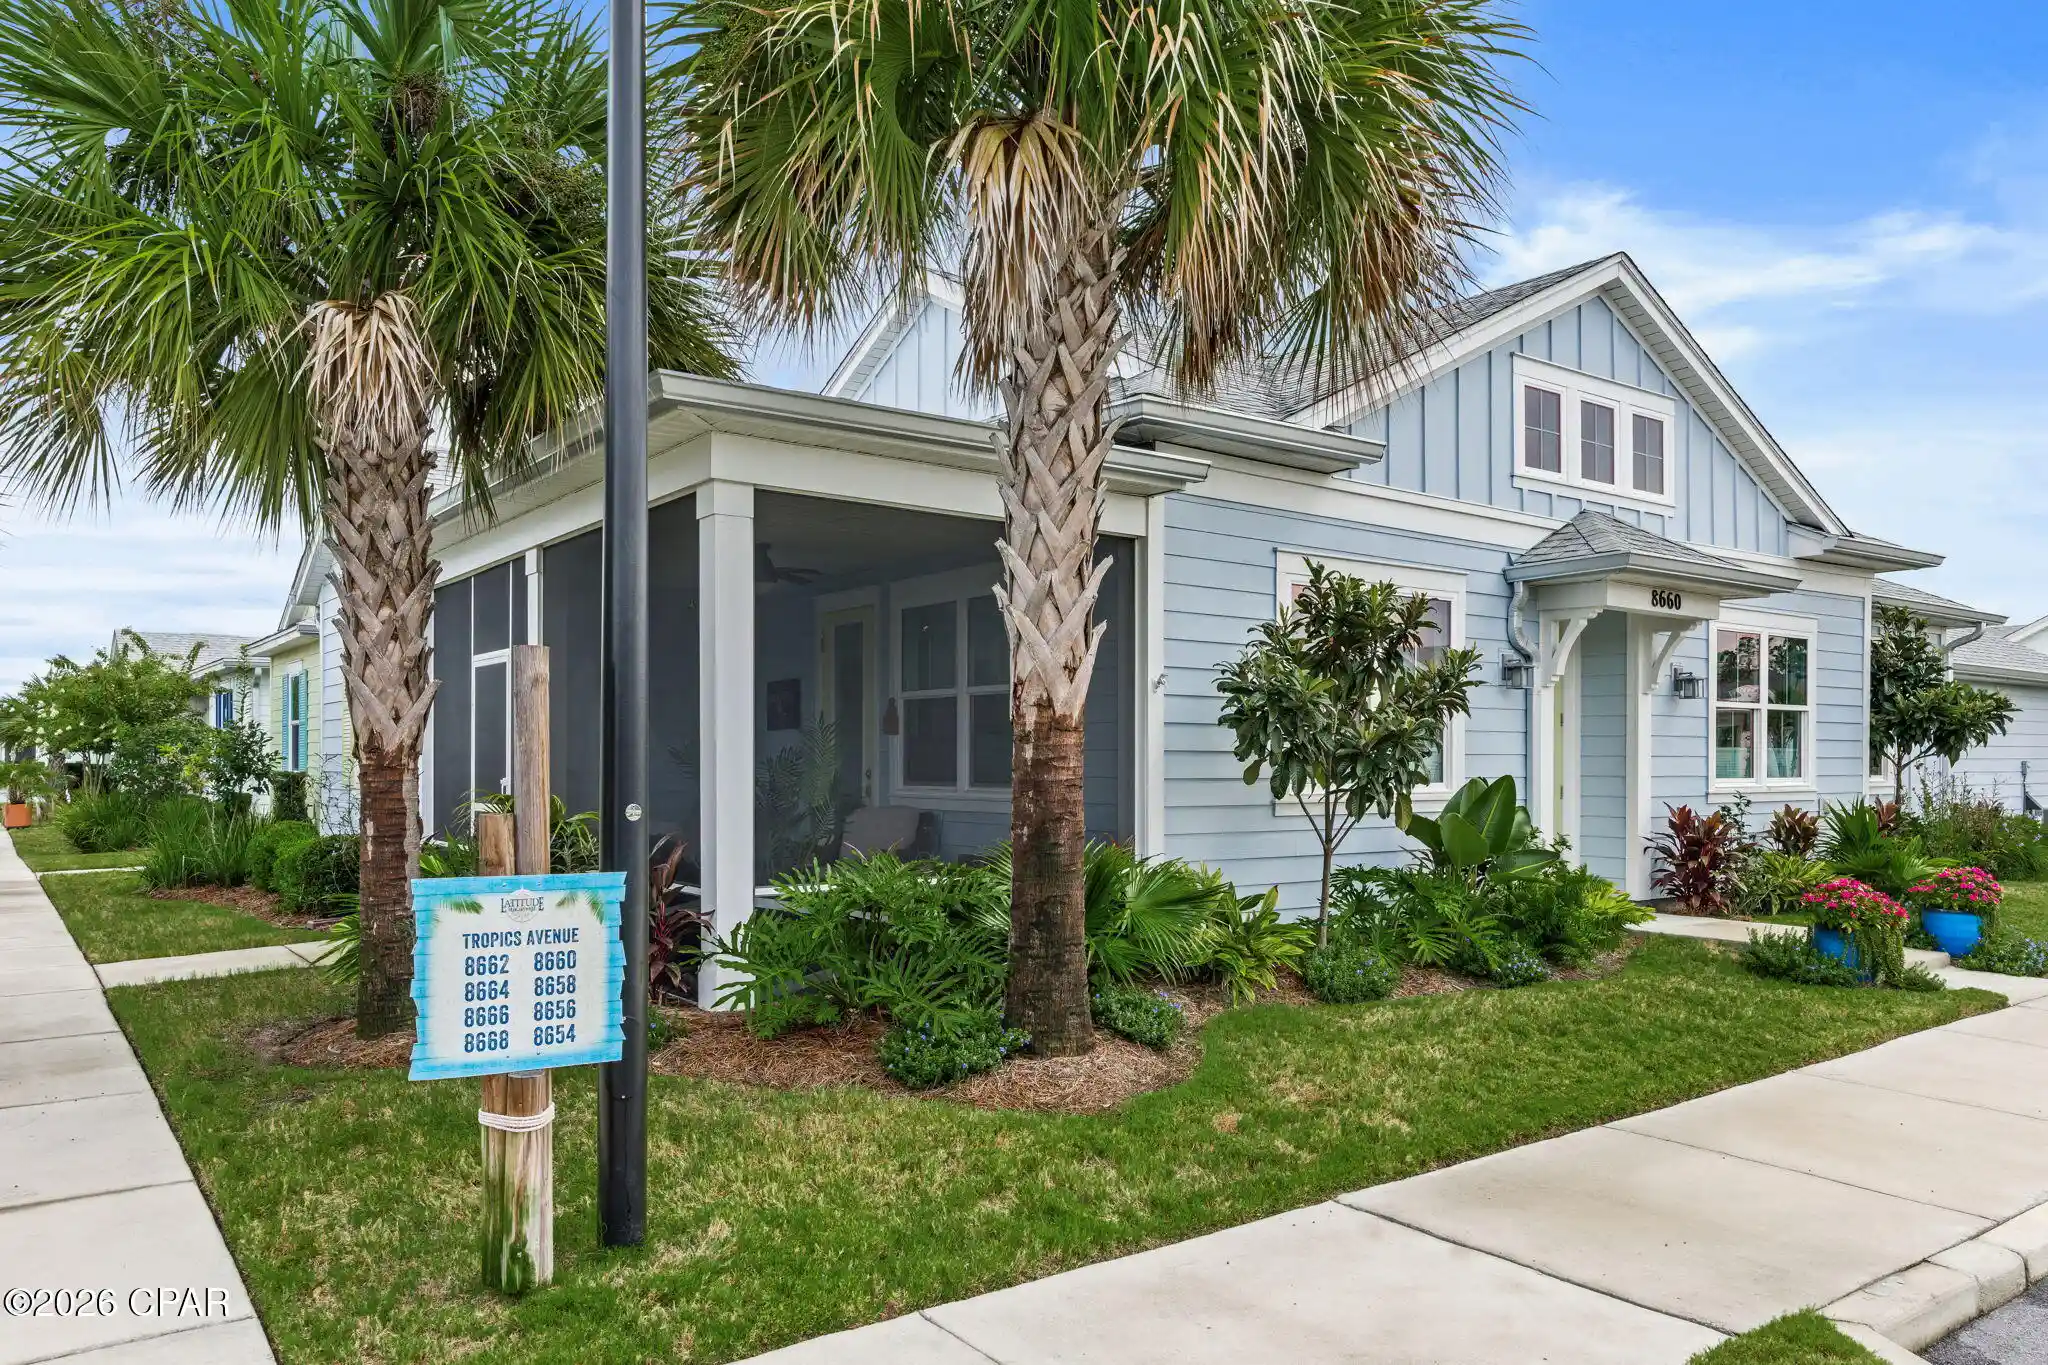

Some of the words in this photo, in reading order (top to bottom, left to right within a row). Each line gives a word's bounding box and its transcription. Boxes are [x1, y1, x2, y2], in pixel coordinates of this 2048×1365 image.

[1651, 589, 1682, 610] 8660
[500, 896, 544, 913] LATITUDE
[462, 931, 522, 949] TROPICS
[526, 927, 580, 945] AVENUE
[464, 954, 510, 976] 8662
[533, 949, 577, 972] 8660
[464, 979, 510, 1002] 8664
[533, 974, 577, 996] 8658
[463, 1004, 510, 1028] 8666
[533, 998, 577, 1021] 8656
[463, 1029, 510, 1053] 8668
[533, 1023, 577, 1046] 8654
